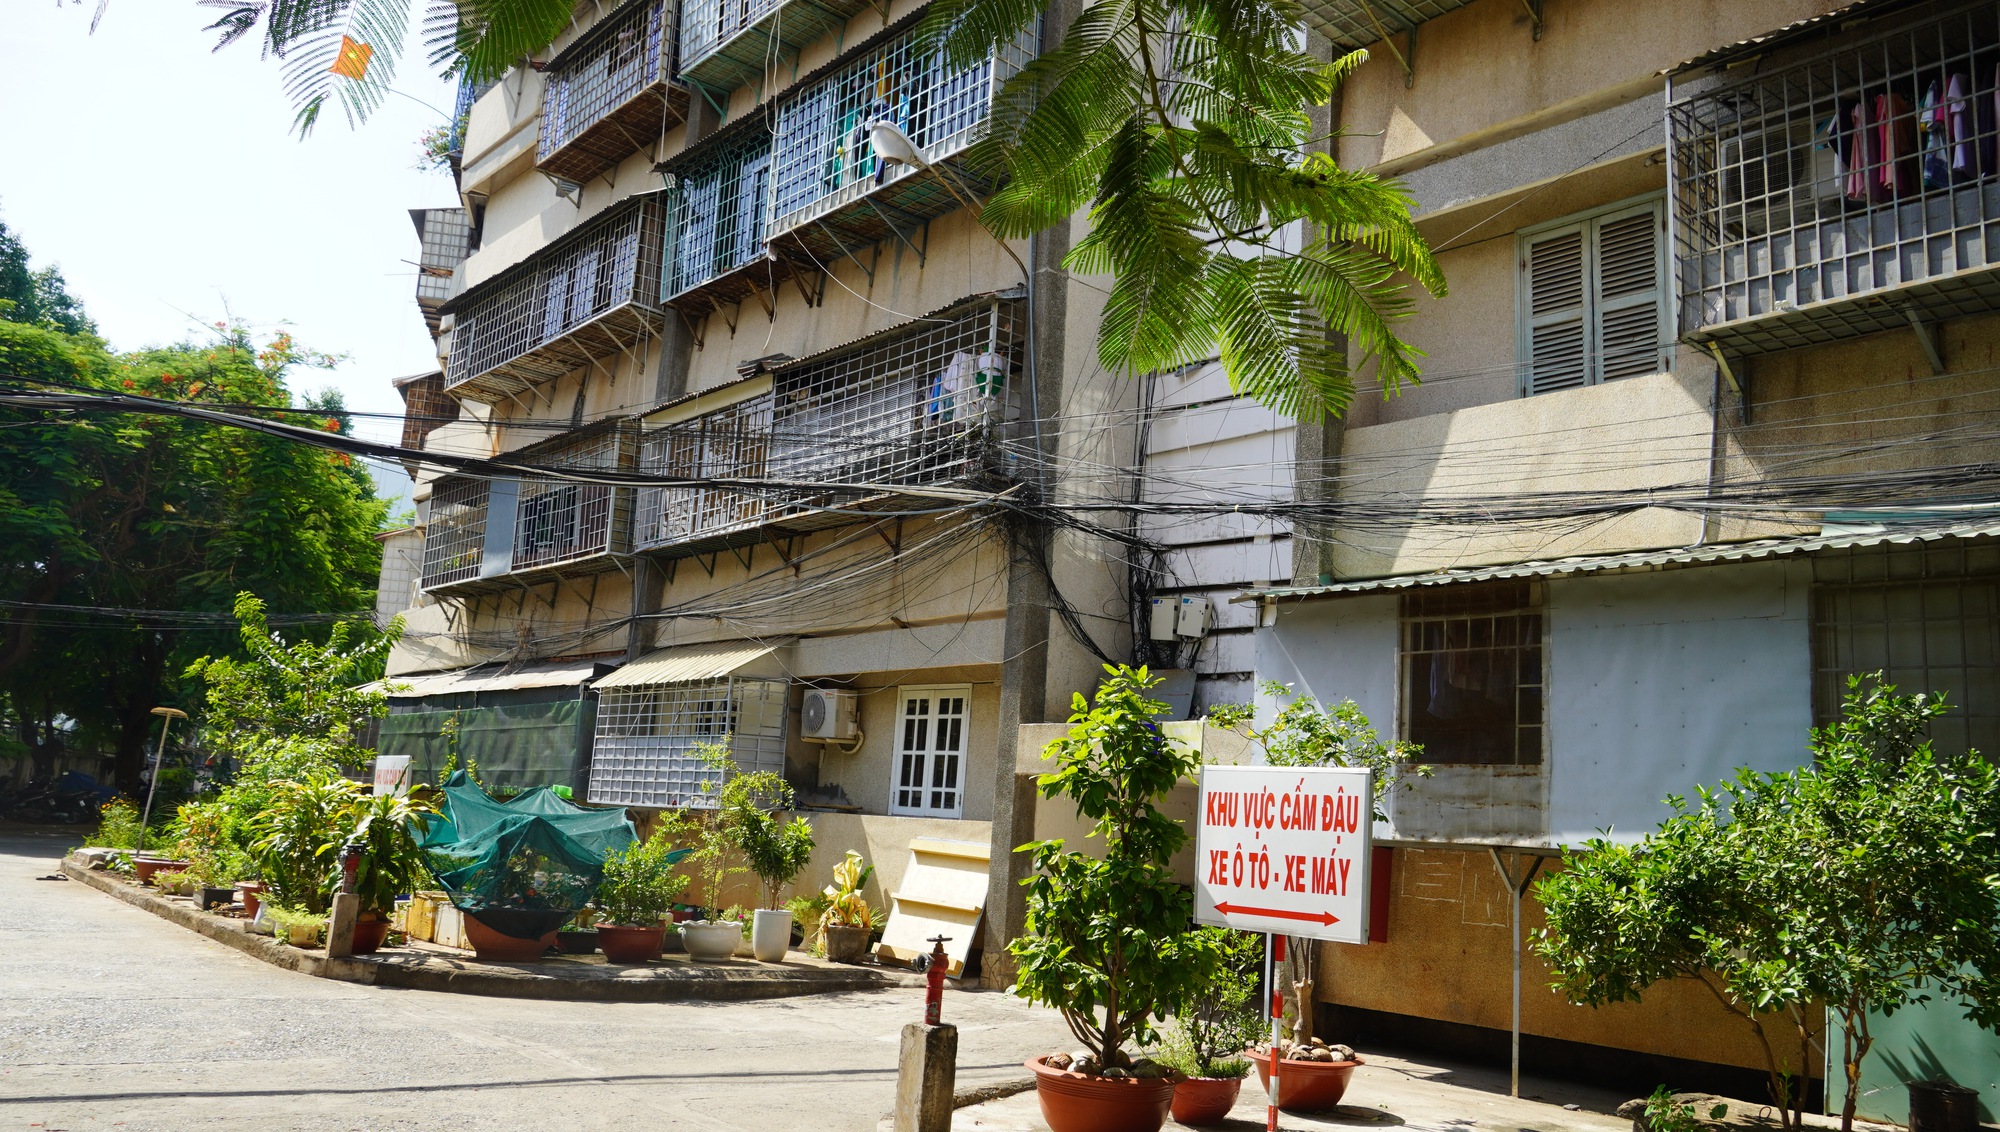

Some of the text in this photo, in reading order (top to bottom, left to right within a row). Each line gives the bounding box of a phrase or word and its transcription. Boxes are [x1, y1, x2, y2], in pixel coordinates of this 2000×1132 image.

[1206, 777, 1359, 845] KHU VỰC CẤM ĐẬU
[1208, 849, 1228, 886] XE
[1232, 842, 1244, 888] Ô
[1248, 844, 1270, 890] TÔ
[1283, 854, 1306, 893] XE
[1311, 848, 1351, 897] MÁY
